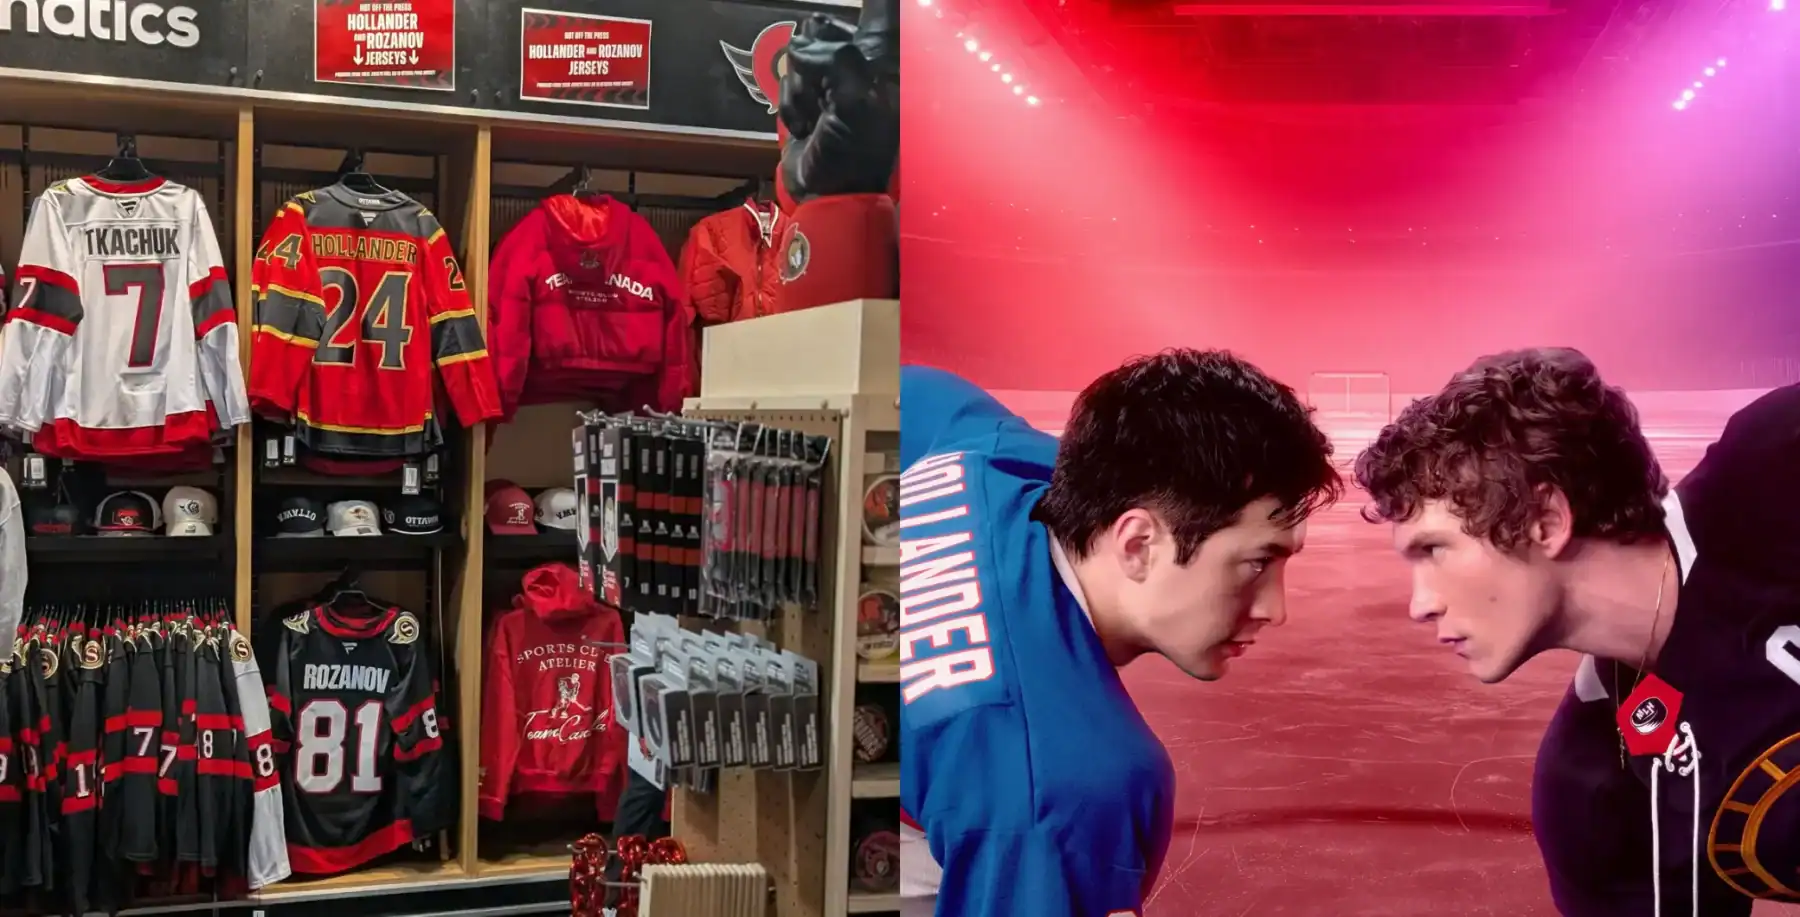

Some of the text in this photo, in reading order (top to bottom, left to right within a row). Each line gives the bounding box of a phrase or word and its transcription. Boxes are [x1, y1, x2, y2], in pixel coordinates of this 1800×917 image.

[347, 13, 418, 30] HOLLANDER
[366, 32, 424, 49] ROZANOV
[529, 44, 585, 59] HOLLANDER
[598, 44, 643, 58] ROZANOV
[365, 51, 407, 65] JERSEYS
[568, 60, 609, 76] JERSEYS
[85, 228, 180, 255] TKACHUK
[311, 233, 418, 265] HOLLANDER
[18, 276, 37, 309] 7
[604, 273, 654, 301] NADA
[103, 263, 165, 368] 7
[312, 266, 413, 371] 24
[517, 643, 576, 664] SPORTS
[539, 657, 597, 672] ATELIER
[304, 663, 391, 694] ROZANOV
[133, 727, 154, 757] 7
[203, 729, 213, 759] 8
[295, 699, 384, 794] 81
[159, 744, 177, 778] 7
[256, 744, 274, 777] 8
[75, 763, 90, 798] 1
